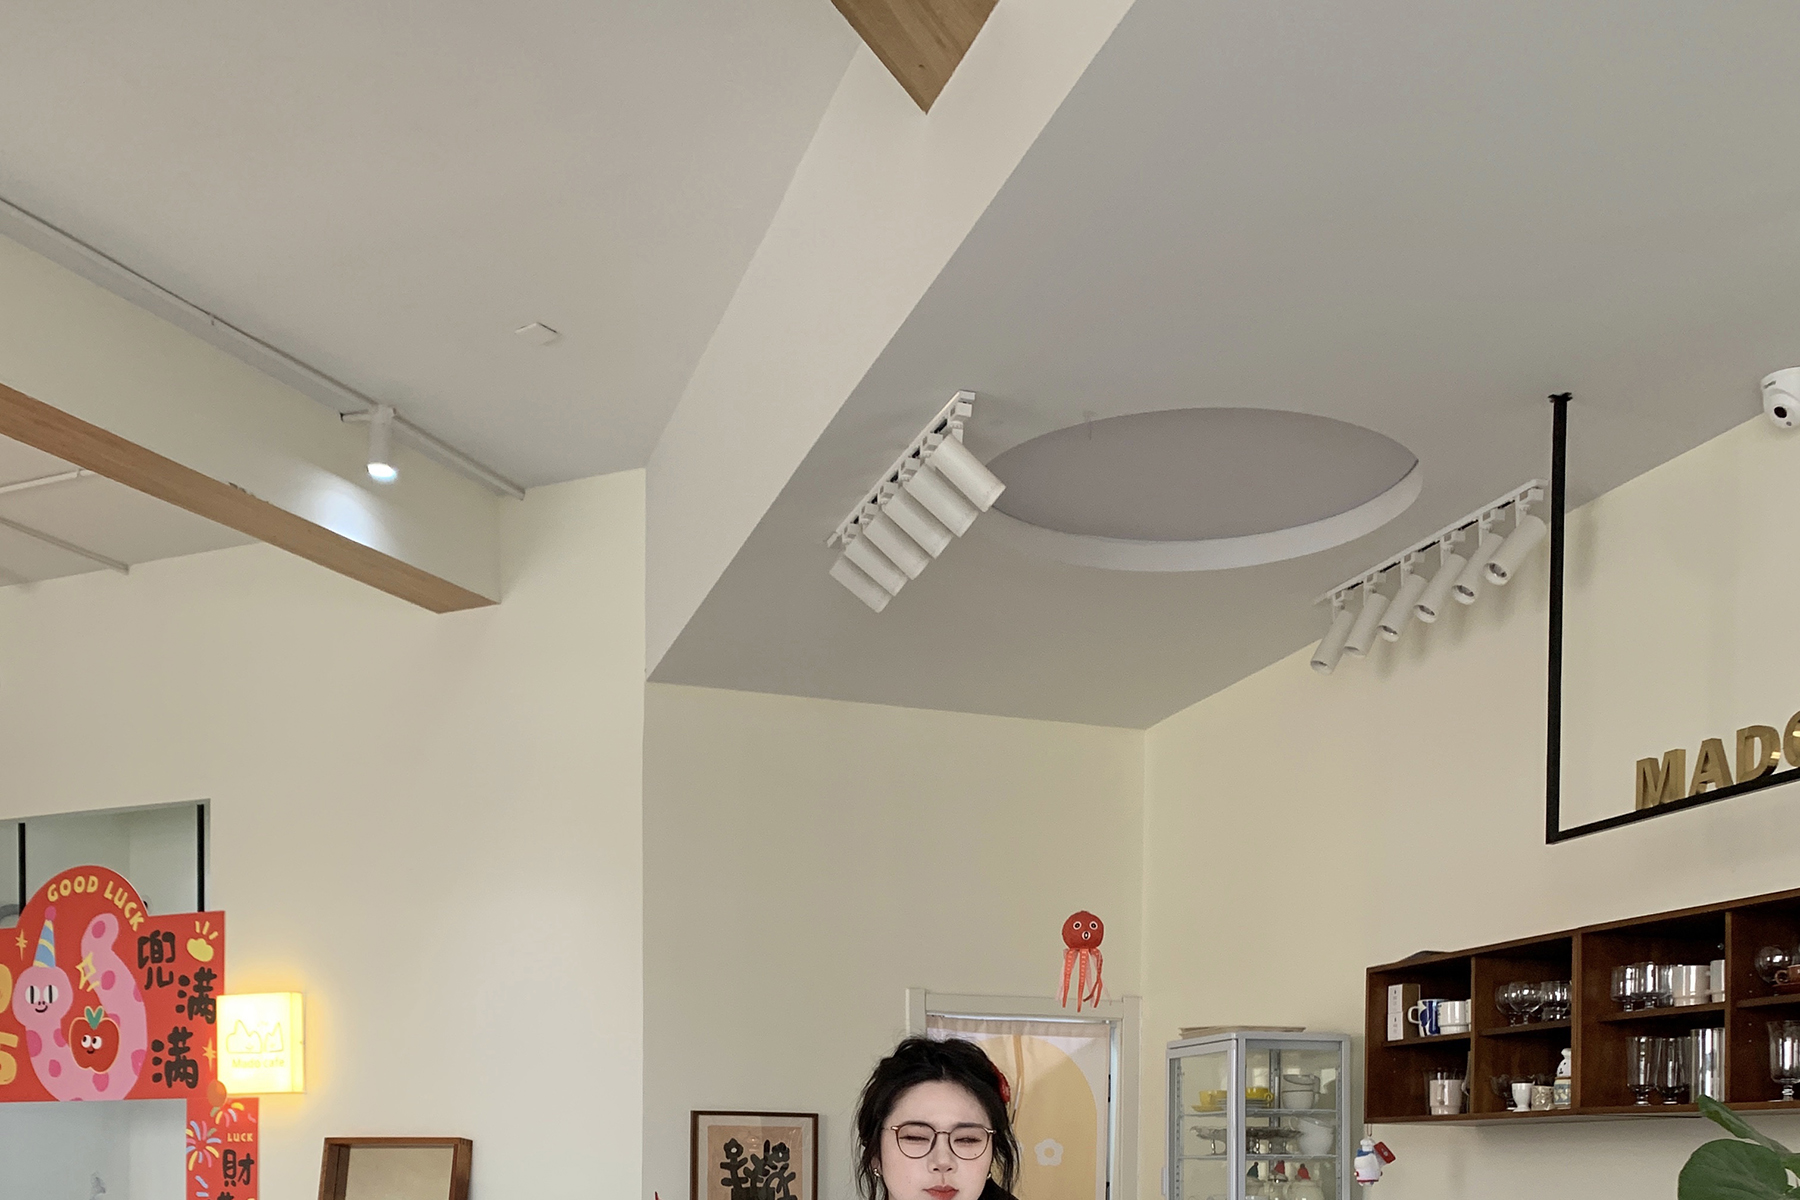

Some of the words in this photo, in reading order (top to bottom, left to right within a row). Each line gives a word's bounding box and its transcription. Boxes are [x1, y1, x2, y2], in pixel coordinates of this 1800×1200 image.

[47, 875, 99, 902] GOOD
[103, 880, 145, 932] LUCK
[227, 1132, 253, 1142] LUCK
